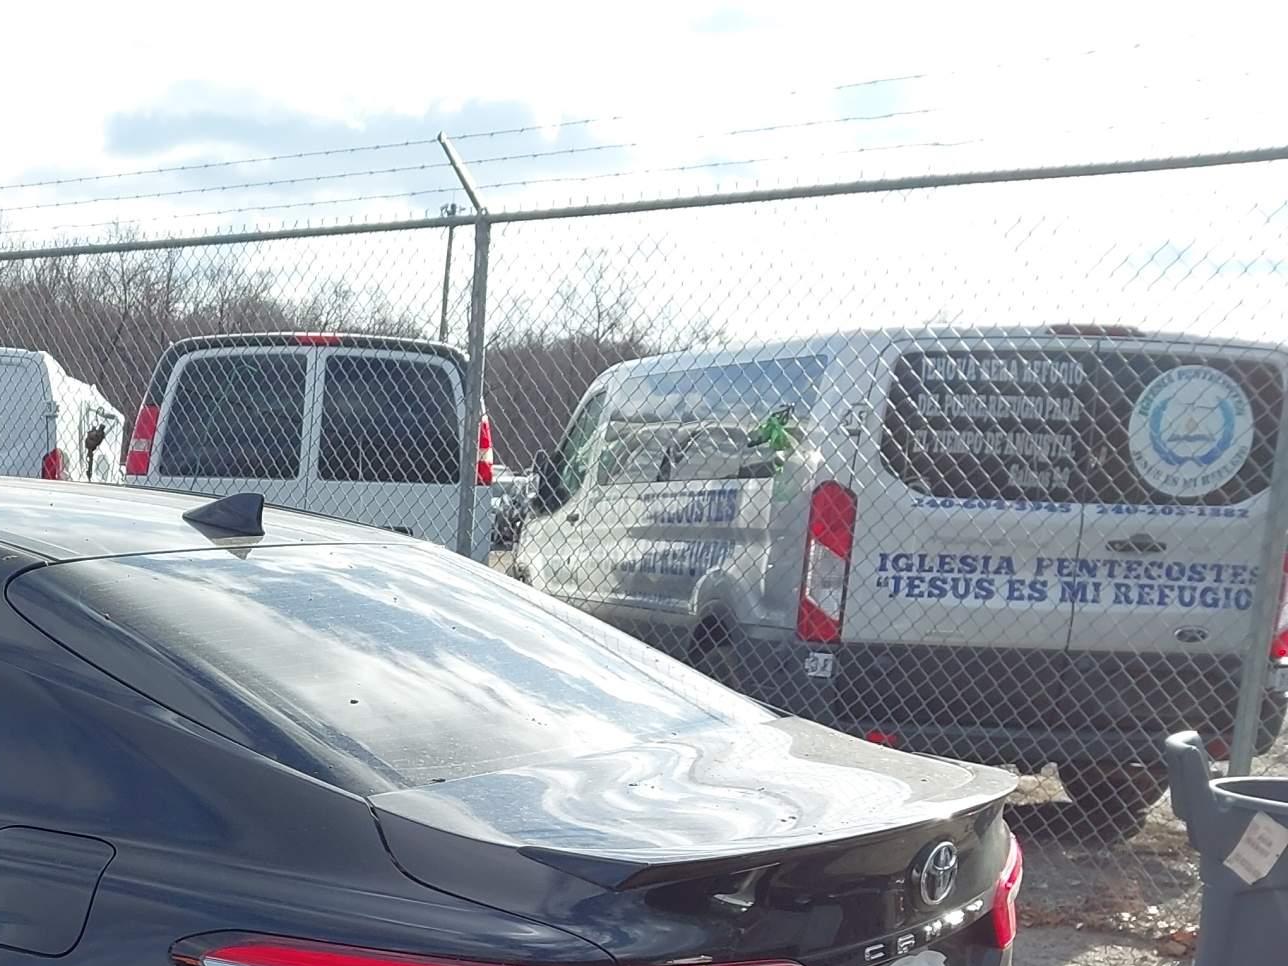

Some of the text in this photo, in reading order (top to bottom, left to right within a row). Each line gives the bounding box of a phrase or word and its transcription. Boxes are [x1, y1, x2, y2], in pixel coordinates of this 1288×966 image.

[878, 553, 1016, 576] IGLESIA
[1006, 579, 1048, 602] ES
[1060, 580, 1102, 604] MI
[1113, 582, 1253, 611] REFUGIO
